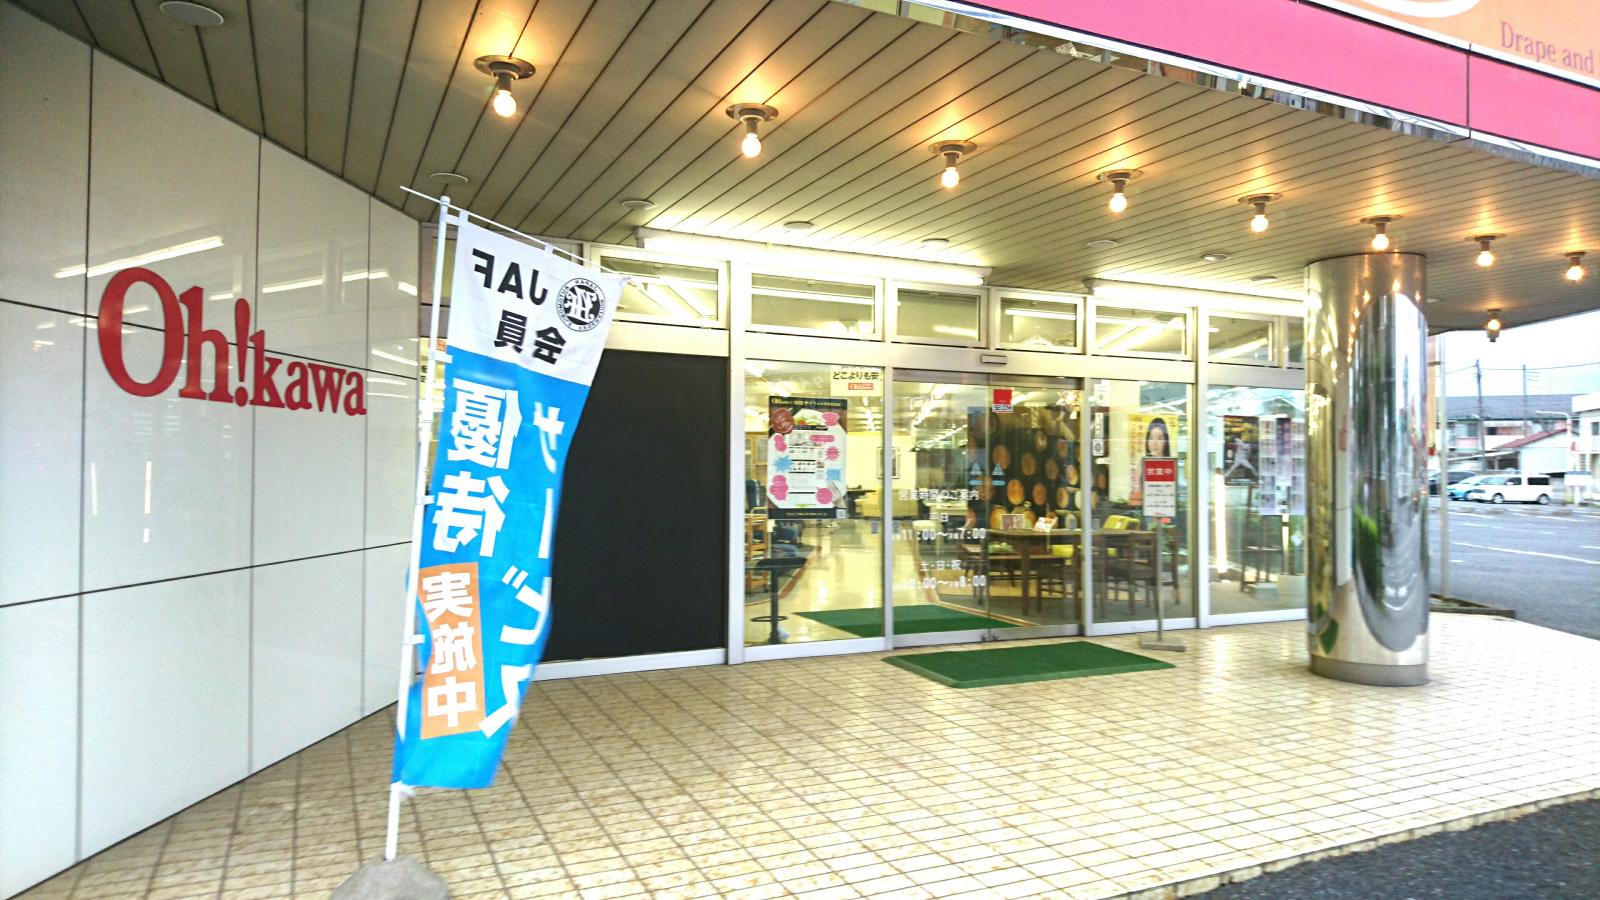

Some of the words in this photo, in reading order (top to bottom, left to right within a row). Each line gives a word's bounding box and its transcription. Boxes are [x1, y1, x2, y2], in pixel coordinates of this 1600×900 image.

[1501, 21, 1557, 63] Drape
[1562, 49, 1595, 75] and
[97, 267, 367, 417] Oh!kawa
[832, 371, 880, 380] どこよりも安
